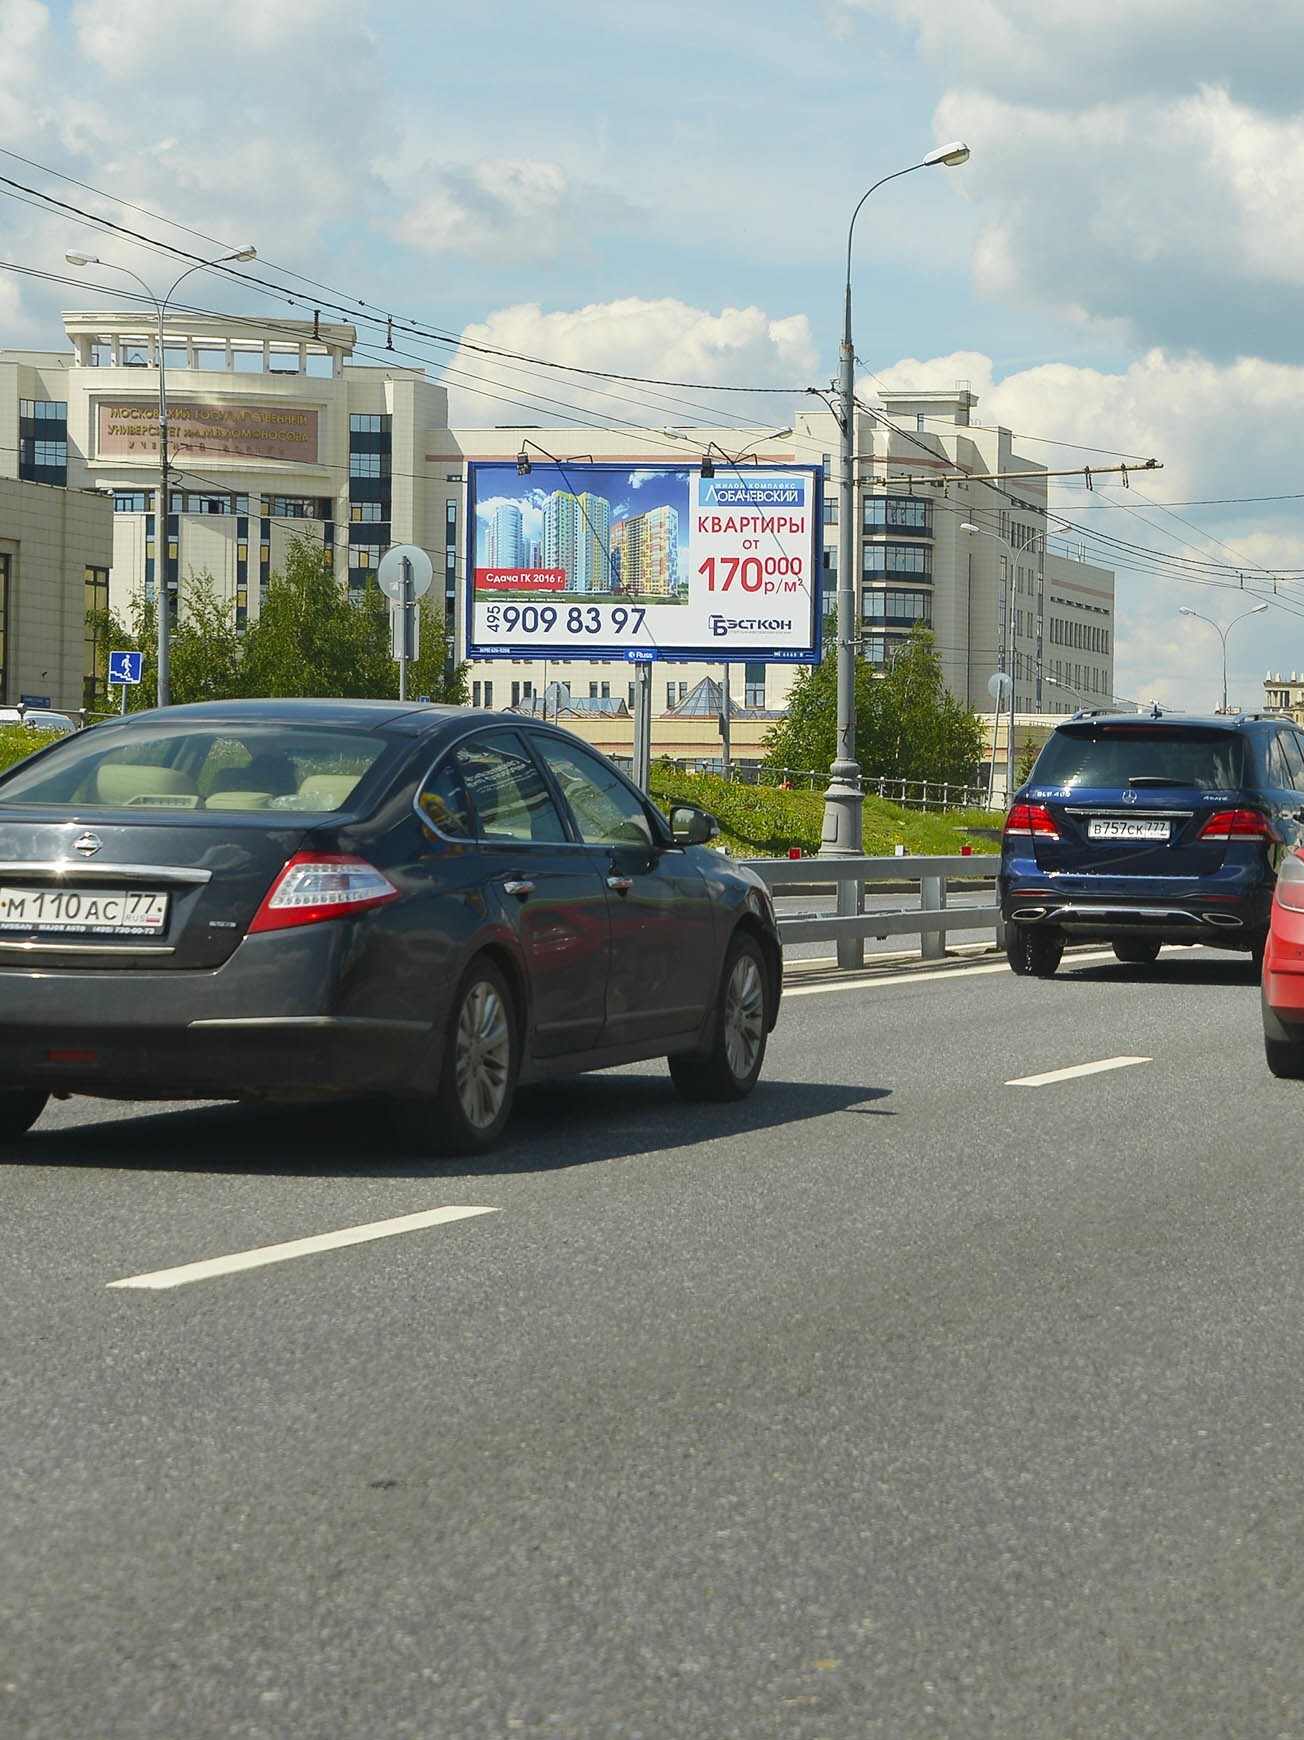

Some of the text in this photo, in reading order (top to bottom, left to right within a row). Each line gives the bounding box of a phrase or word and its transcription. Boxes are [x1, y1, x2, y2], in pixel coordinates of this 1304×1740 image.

[110, 408, 190, 420] МОСКОВКИЙ
[107, 424, 182, 437] УНИВЕРСЕТ
[705, 485, 798, 502] ЛОБАЧЕВСКИЙ
[698, 516, 805, 534] КВАРТИРЫ
[486, 573, 519, 584] Сдача
[520, 574, 532, 583] ГК
[533, 574, 556, 583] 2016
[698, 557, 763, 592] 170
[486, 606, 501, 633] 495
[502, 606, 646, 634] 909 83 97
[130, 893, 157, 914] 77
